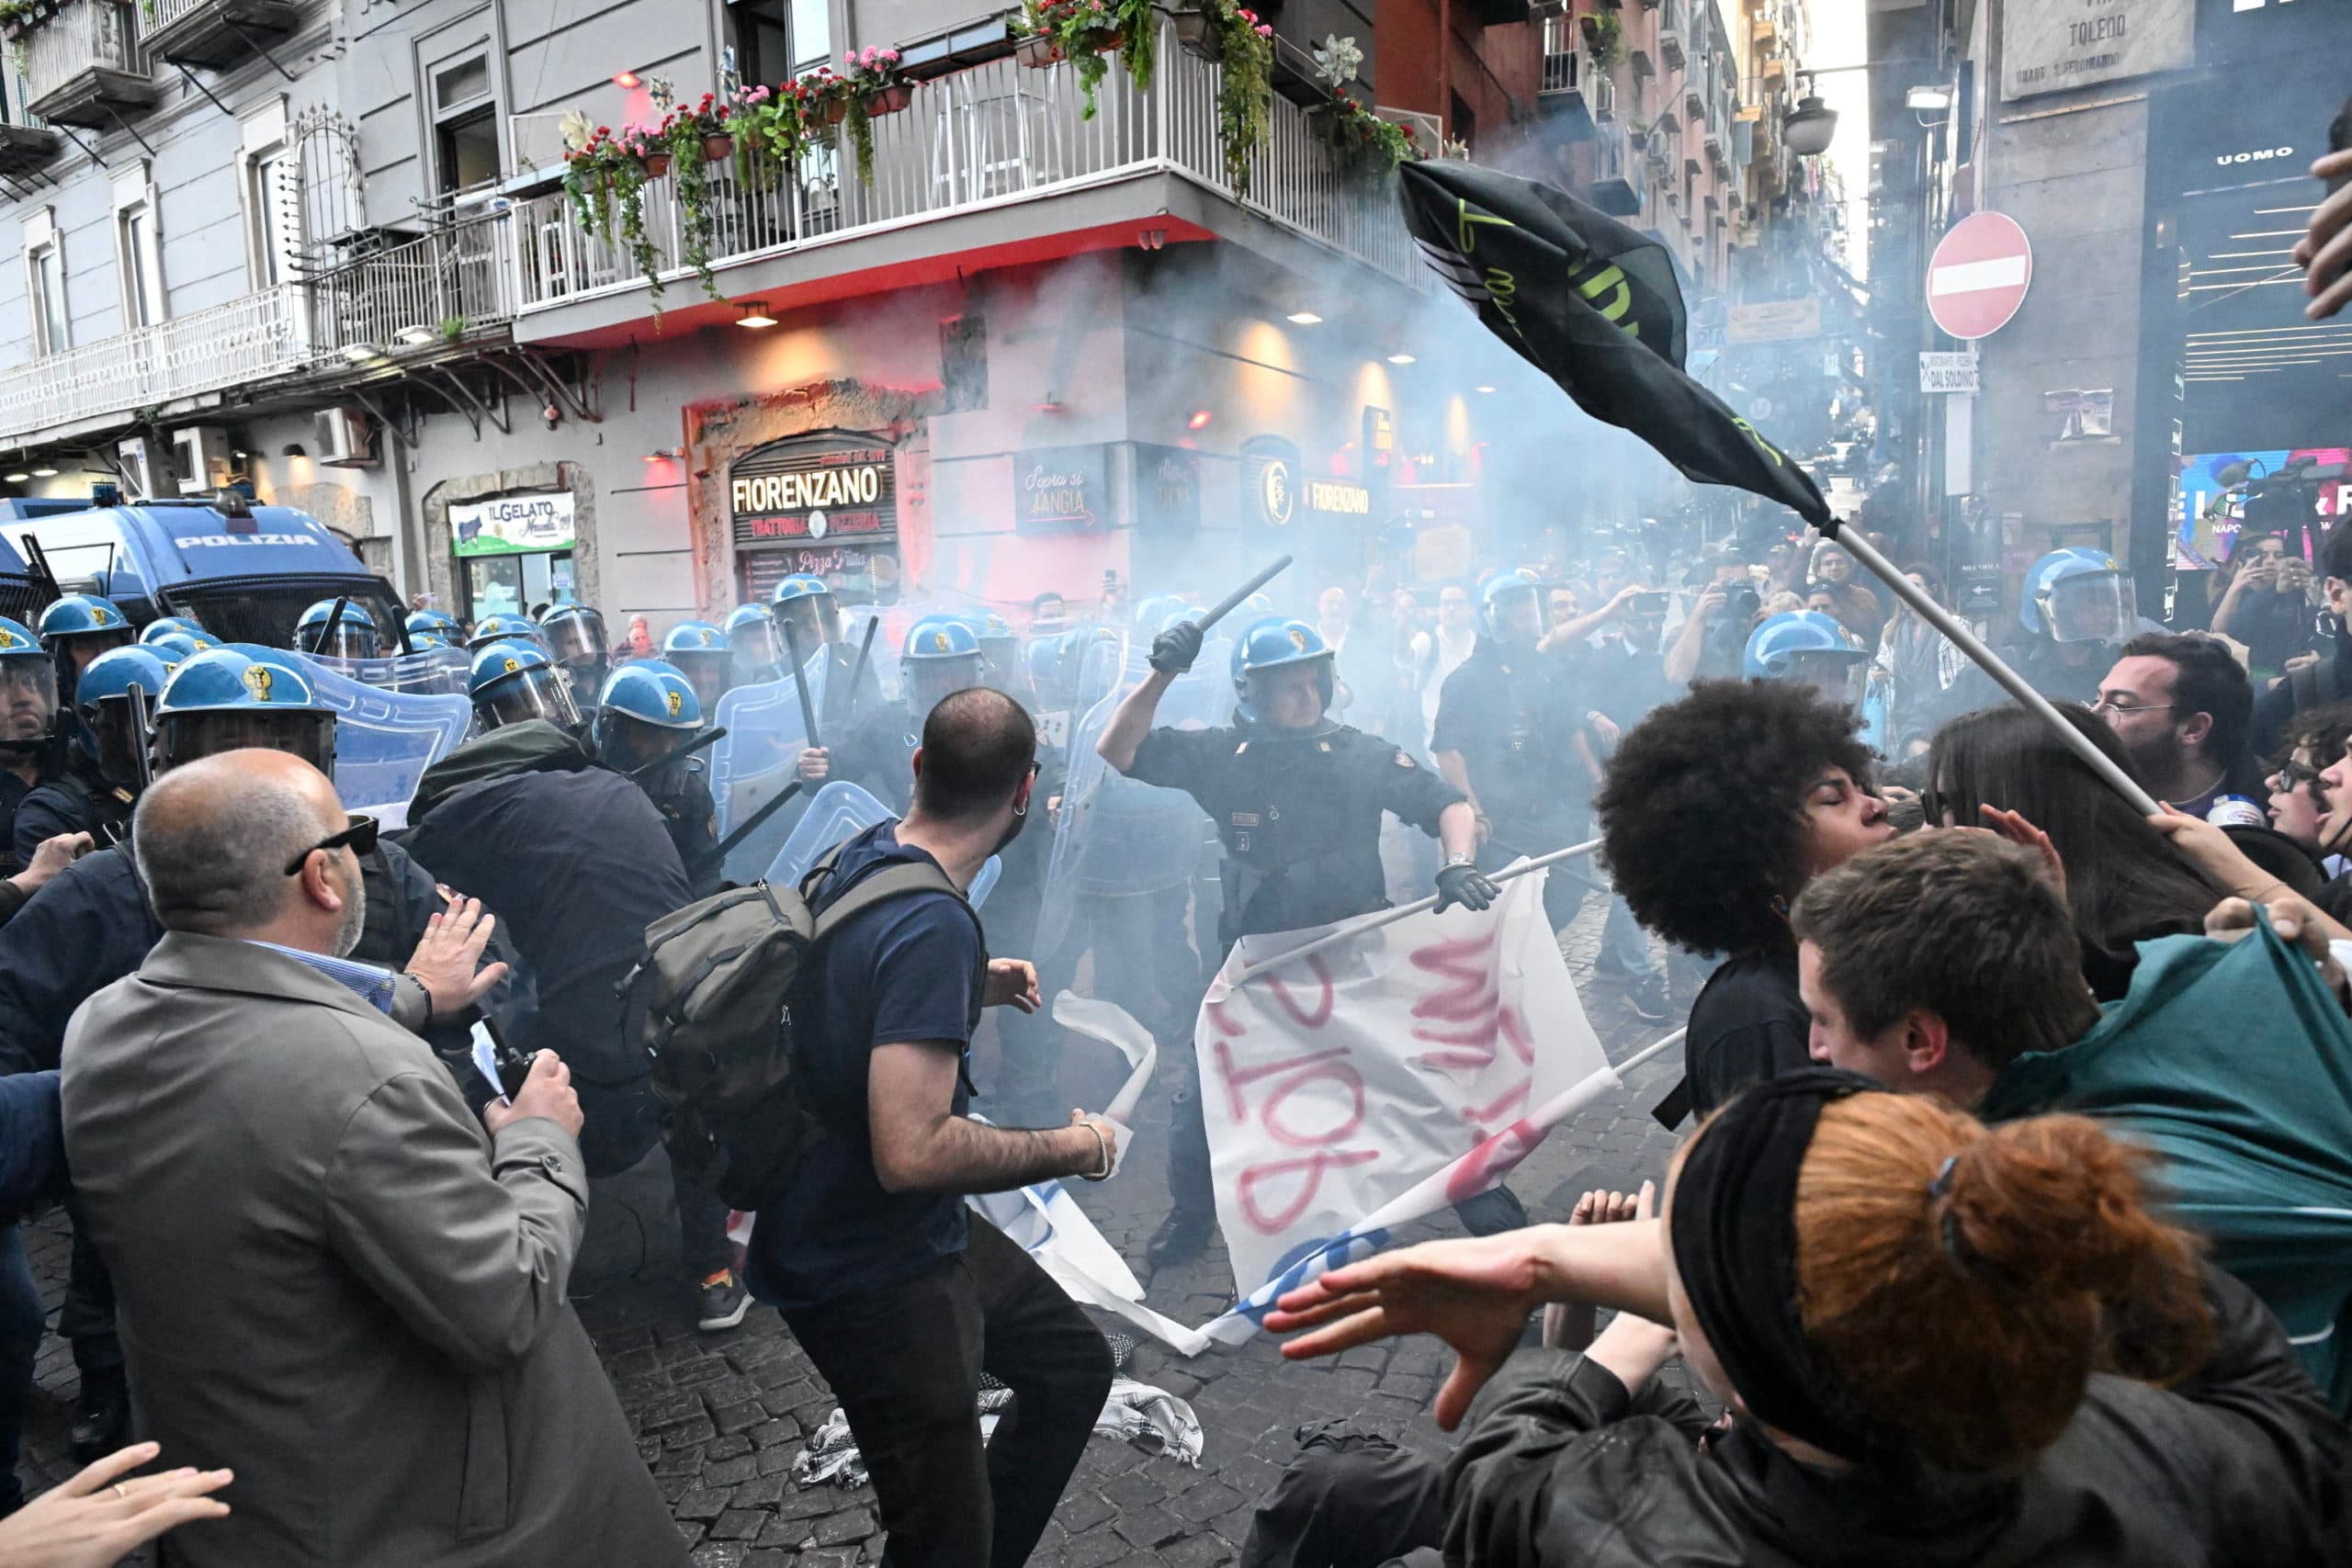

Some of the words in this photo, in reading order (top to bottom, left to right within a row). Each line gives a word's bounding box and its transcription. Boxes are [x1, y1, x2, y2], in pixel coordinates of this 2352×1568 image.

[2069, 14, 2126, 47] TOLEDO
[2217, 146, 2294, 165] UOMO
[1931, 370, 1945, 389] DAL
[1946, 369, 1974, 389] SOLDINO
[732, 466, 878, 513] FIORENZANO
[1025, 464, 1067, 492] Sopra
[1069, 469, 1083, 487] si
[1312, 482, 1369, 515] FIORENZANO
[750, 516, 807, 537] TRATTORIA
[174, 534, 319, 549] POLIZIA
[797, 550, 832, 576] Pizza
